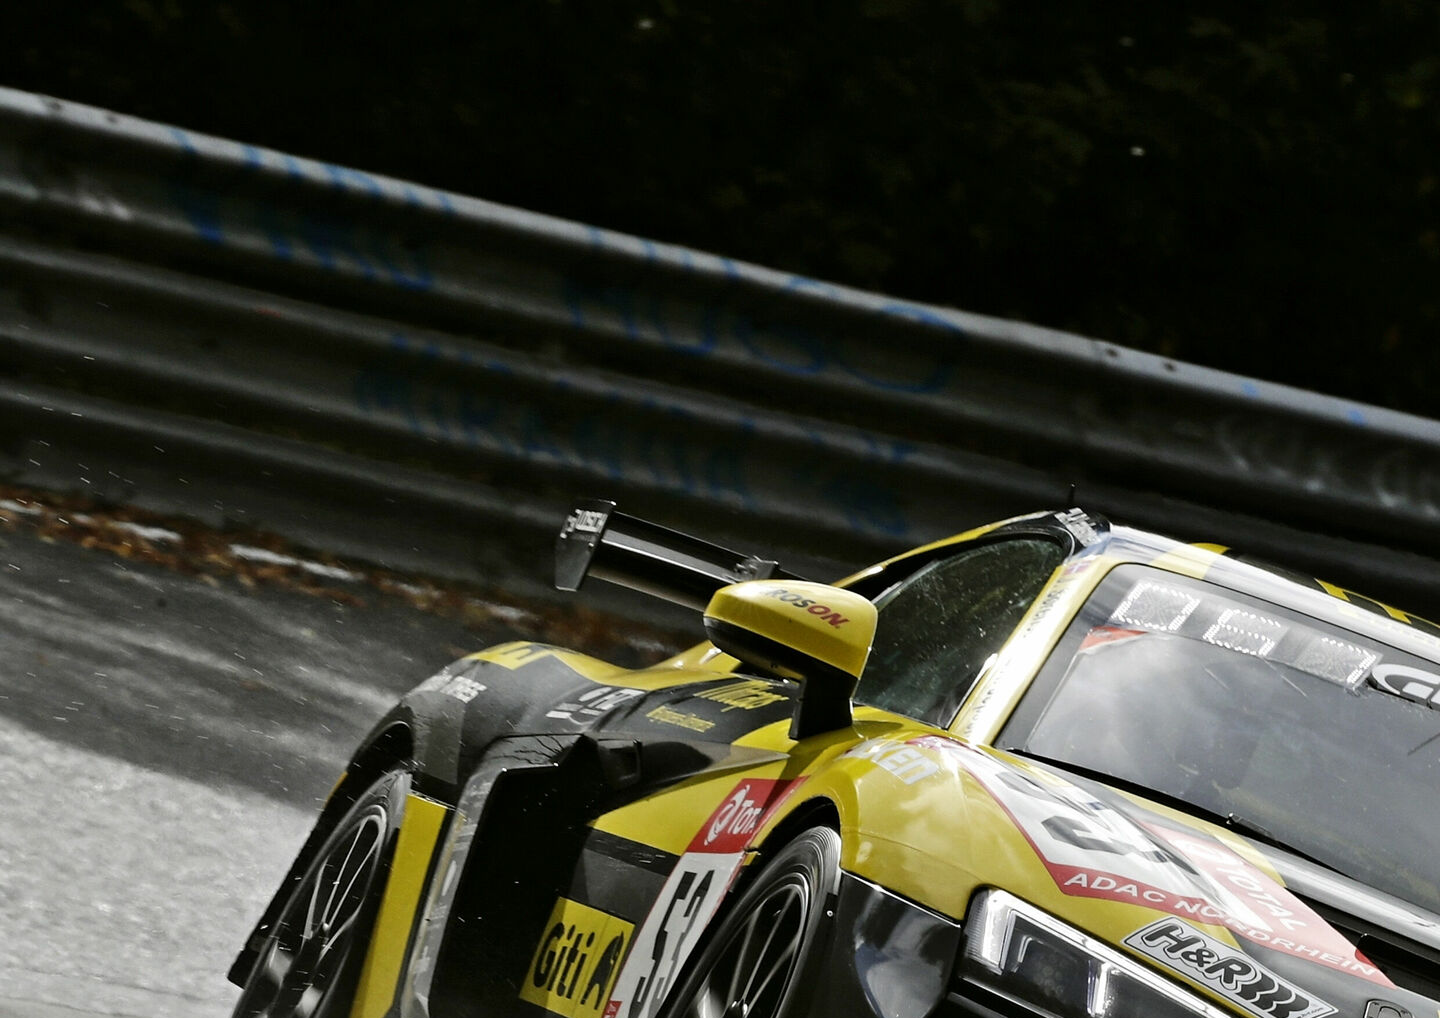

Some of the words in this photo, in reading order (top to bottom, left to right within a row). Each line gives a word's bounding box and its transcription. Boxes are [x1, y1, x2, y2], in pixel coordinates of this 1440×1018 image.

[1063, 872, 1167, 904] ADAC
[533, 922, 596, 1000] Giti
[1142, 922, 1258, 992] H&R
